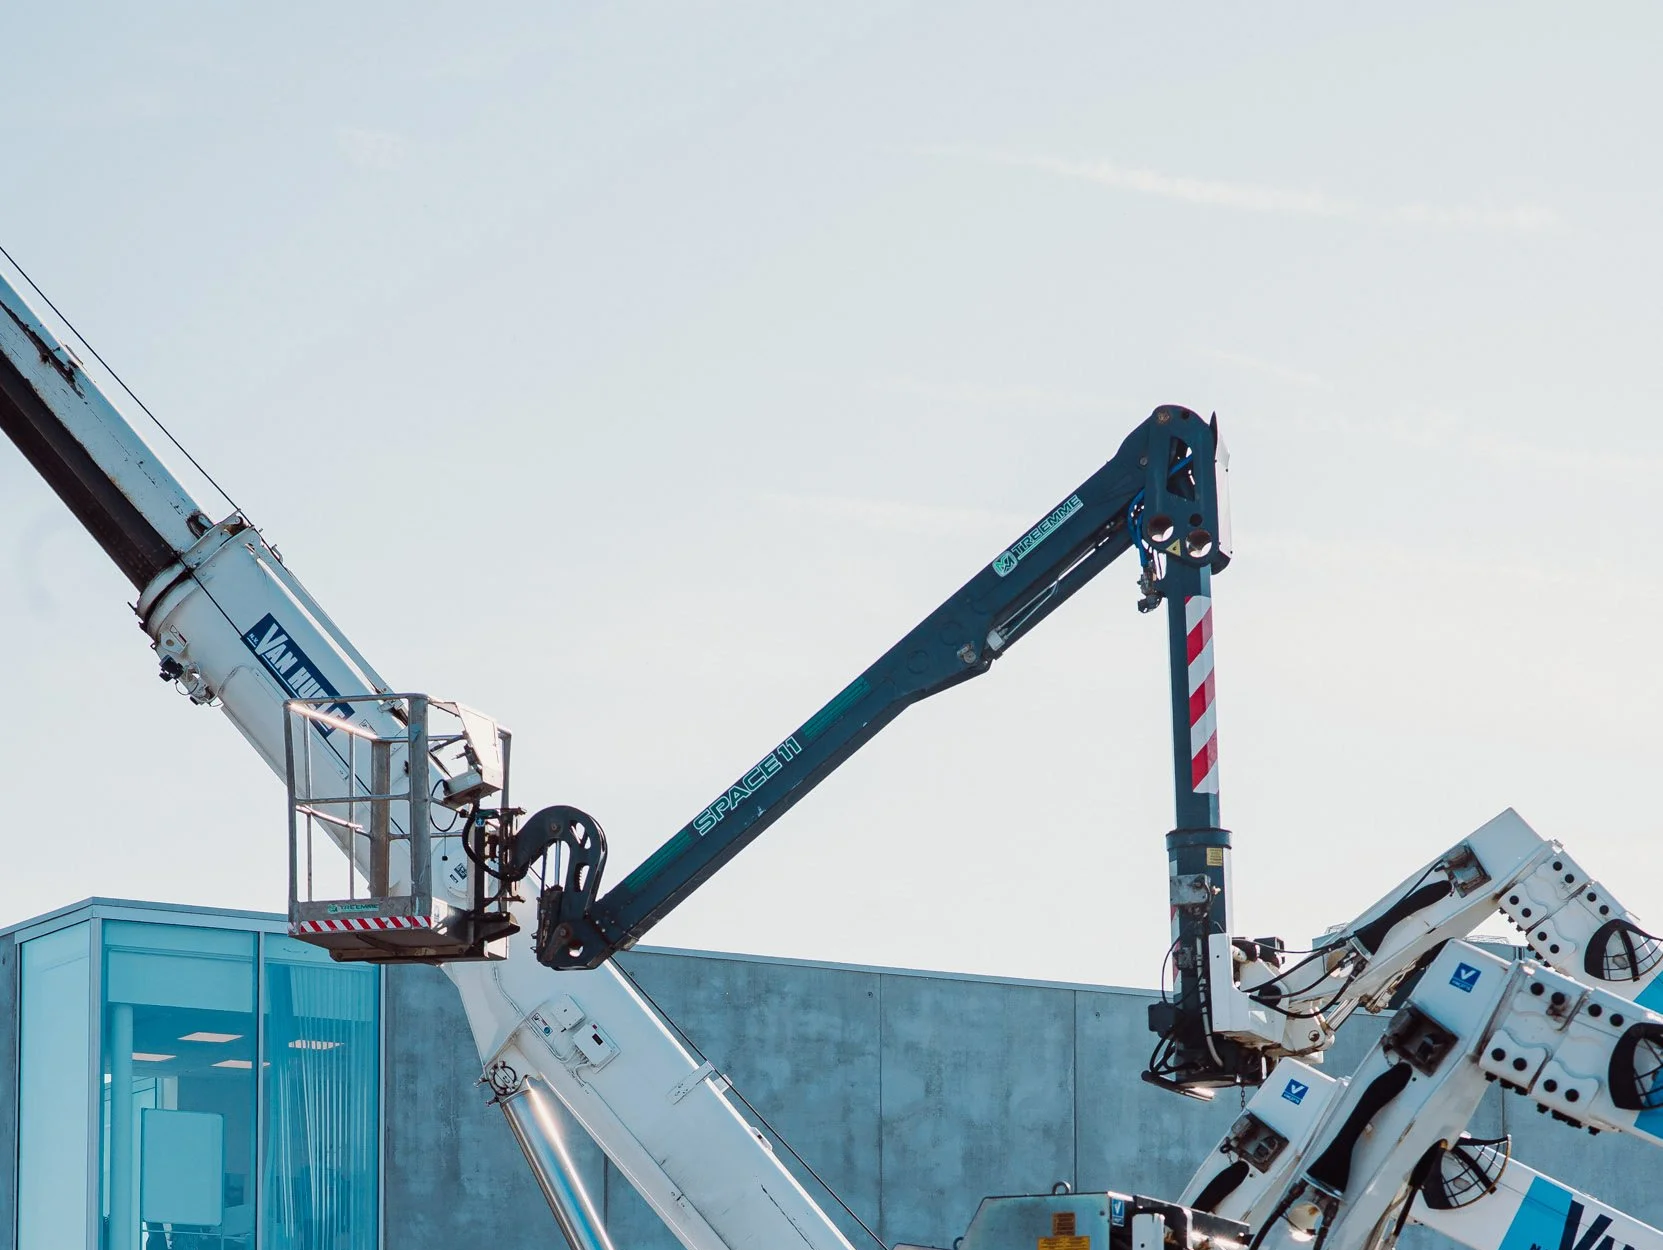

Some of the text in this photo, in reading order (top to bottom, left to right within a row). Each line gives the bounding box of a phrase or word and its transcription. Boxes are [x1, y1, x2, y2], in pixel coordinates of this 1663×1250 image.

[254, 622, 298, 675] VAN
[693, 736, 802, 836] SPACE 11
